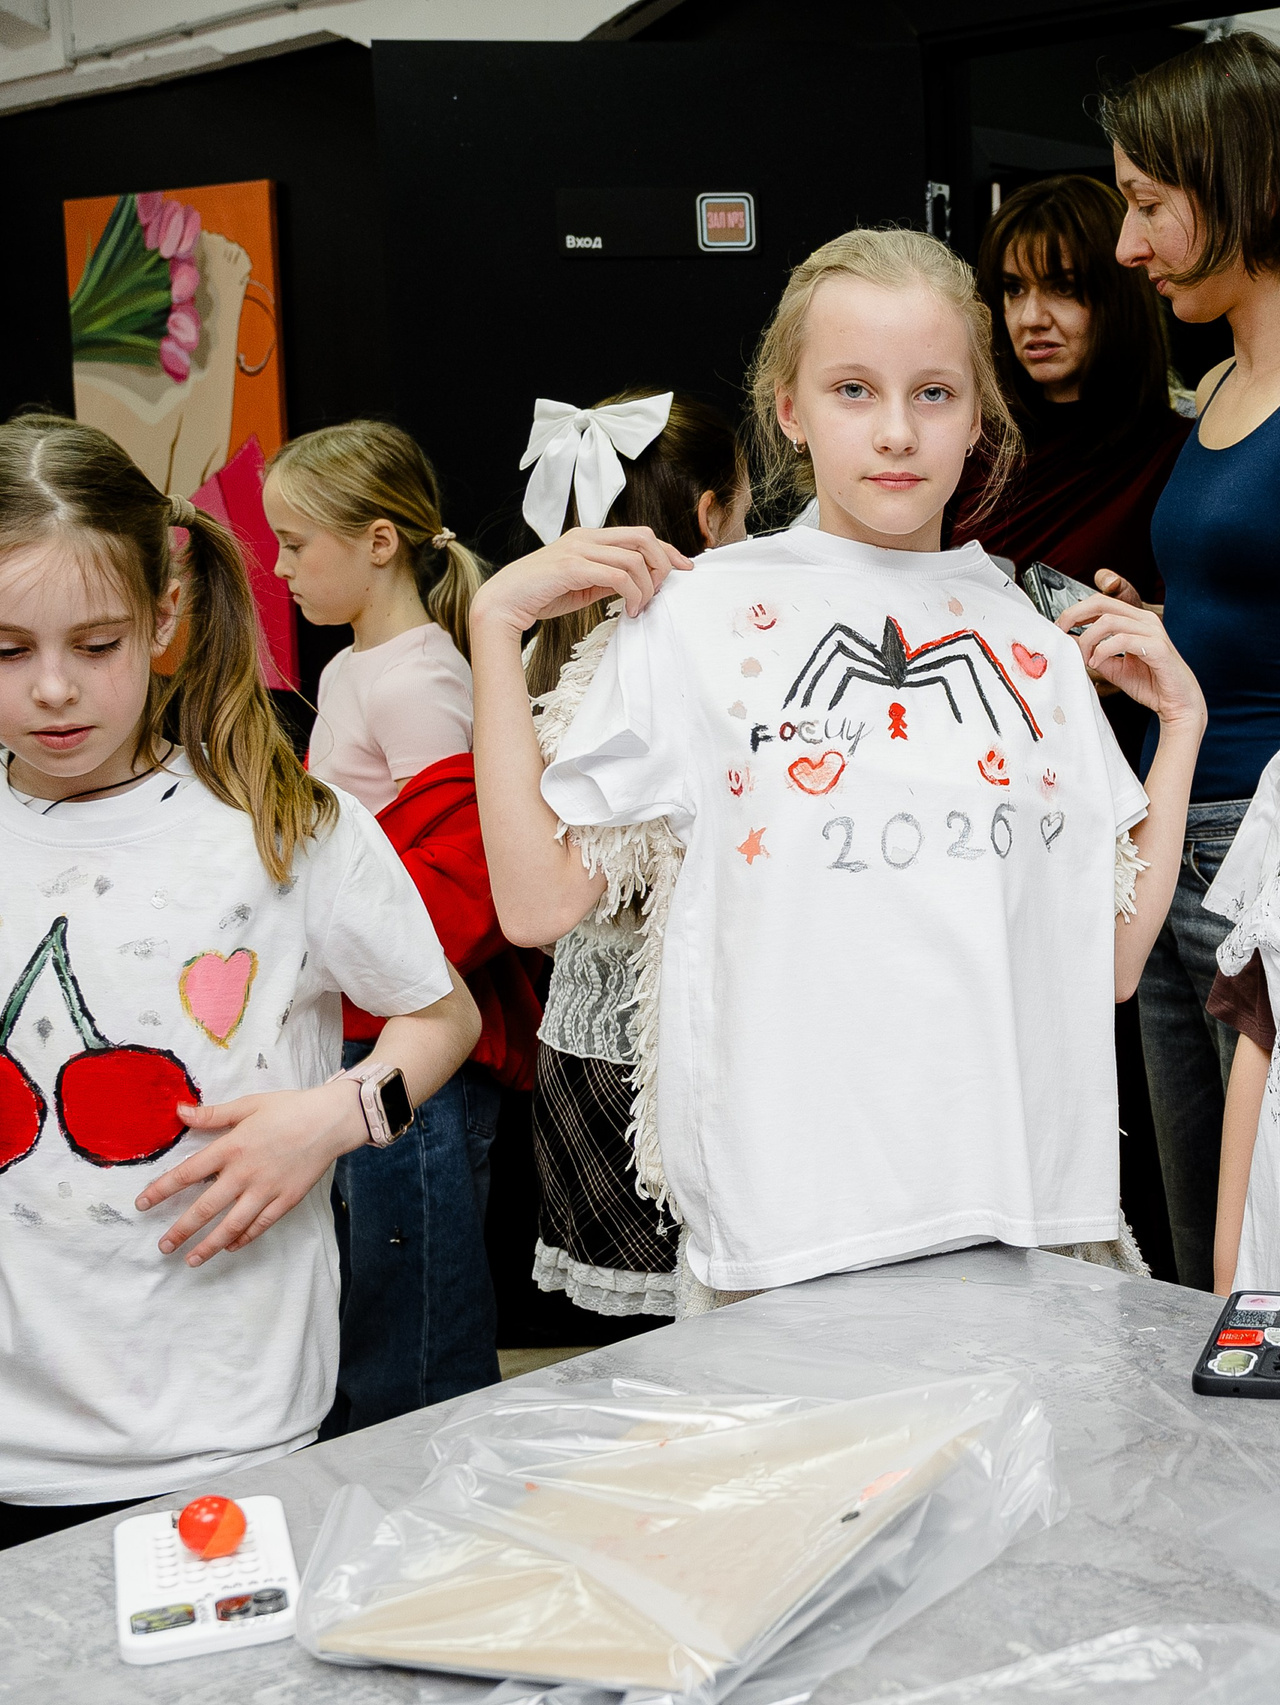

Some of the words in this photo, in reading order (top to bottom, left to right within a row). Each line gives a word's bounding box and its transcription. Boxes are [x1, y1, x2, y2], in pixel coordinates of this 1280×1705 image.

[707, 211, 726, 229] ЗАЛ
[565, 234, 602, 249] Вход
[821, 802, 1017, 874] 2026
